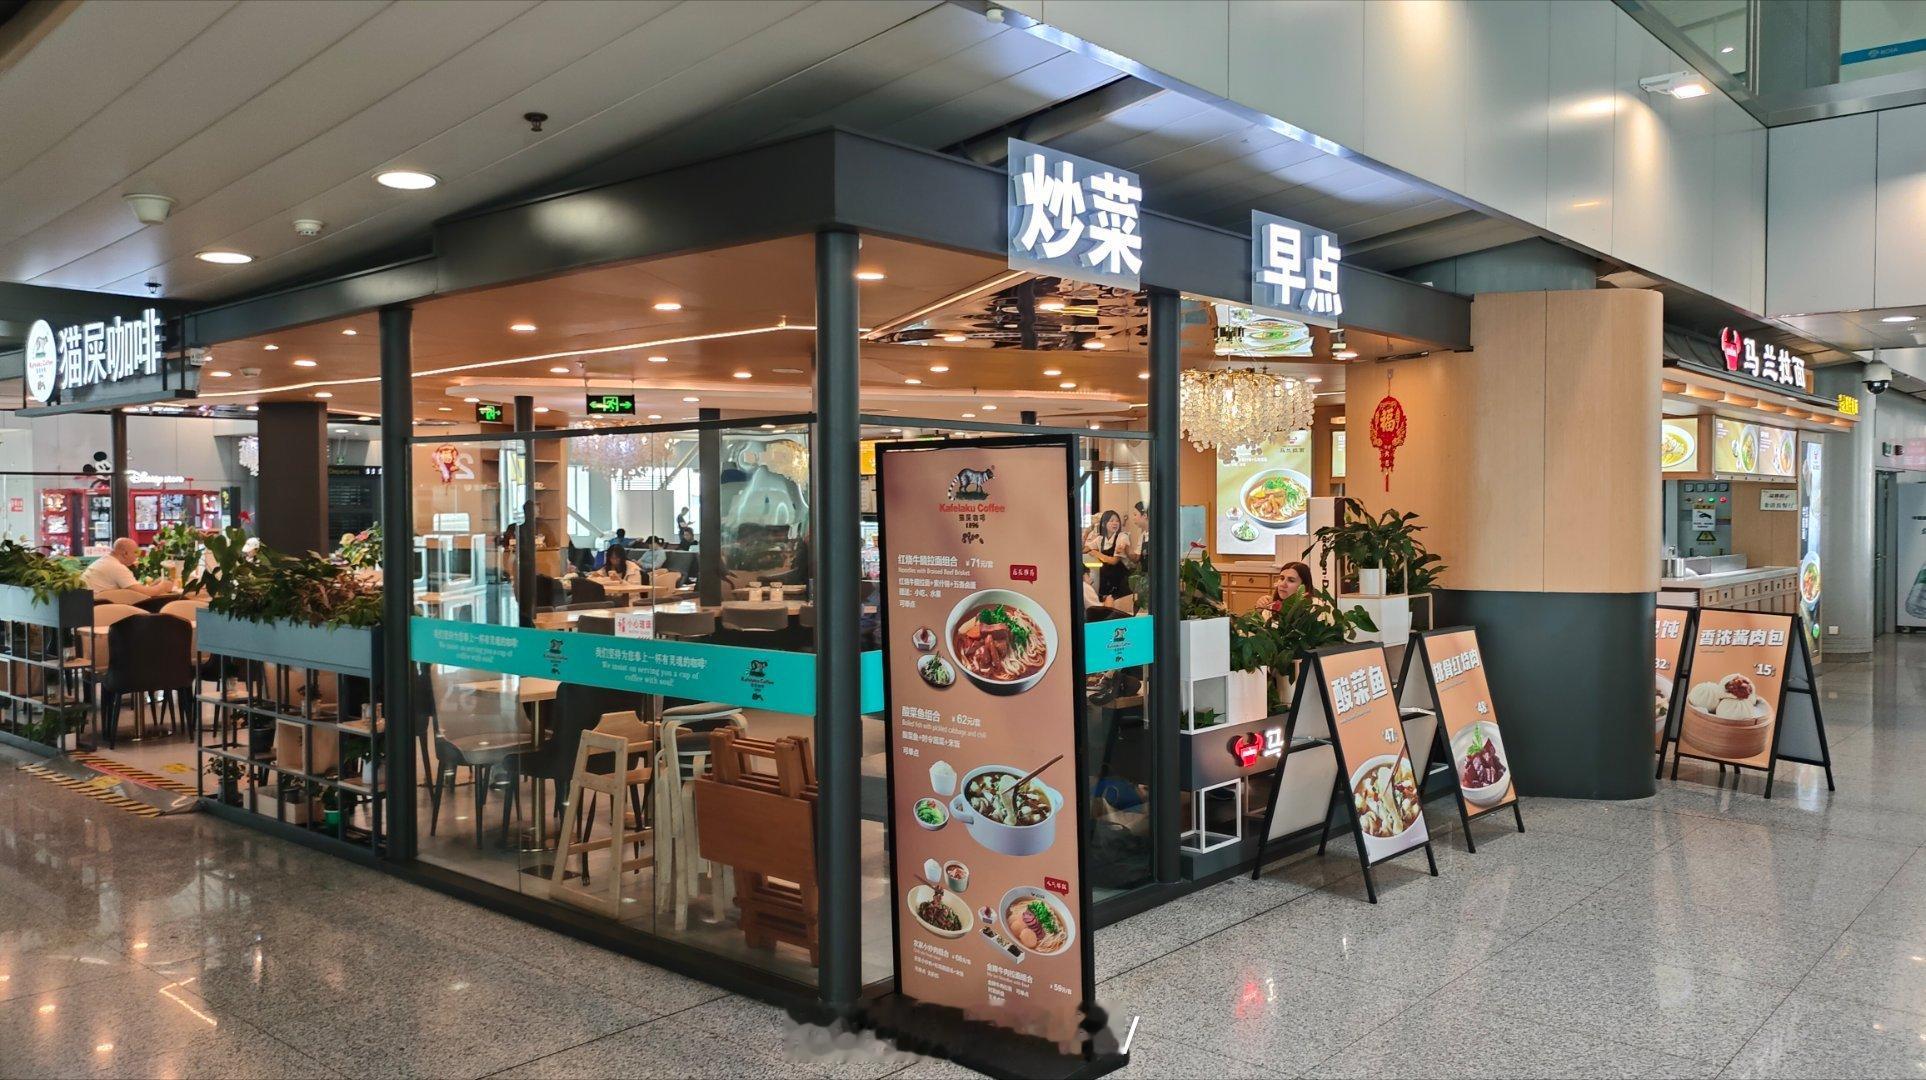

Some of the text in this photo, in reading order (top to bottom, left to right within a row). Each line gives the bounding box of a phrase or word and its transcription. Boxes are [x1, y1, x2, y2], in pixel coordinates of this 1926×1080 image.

[1014, 153, 1143, 275] 炒菜
[1256, 223, 1343, 316] 早点
[58, 308, 163, 389] 猫屎咖啡
[1743, 338, 1806, 388] 马兰拉面
[125, 470, 163, 487] Disney
[938, 503, 1006, 512] Kafelaku Coffee
[1656, 619, 1680, 640] 饨
[1699, 629, 1785, 647] 香浓酱肉包
[612, 663, 628, 671] insist
[638, 667, 660, 677] serving
[625, 674, 643, 682] coffee
[1331, 665, 1388, 715] 酸菜鱼
[901, 705, 941, 722] 酸菜鱼组合
